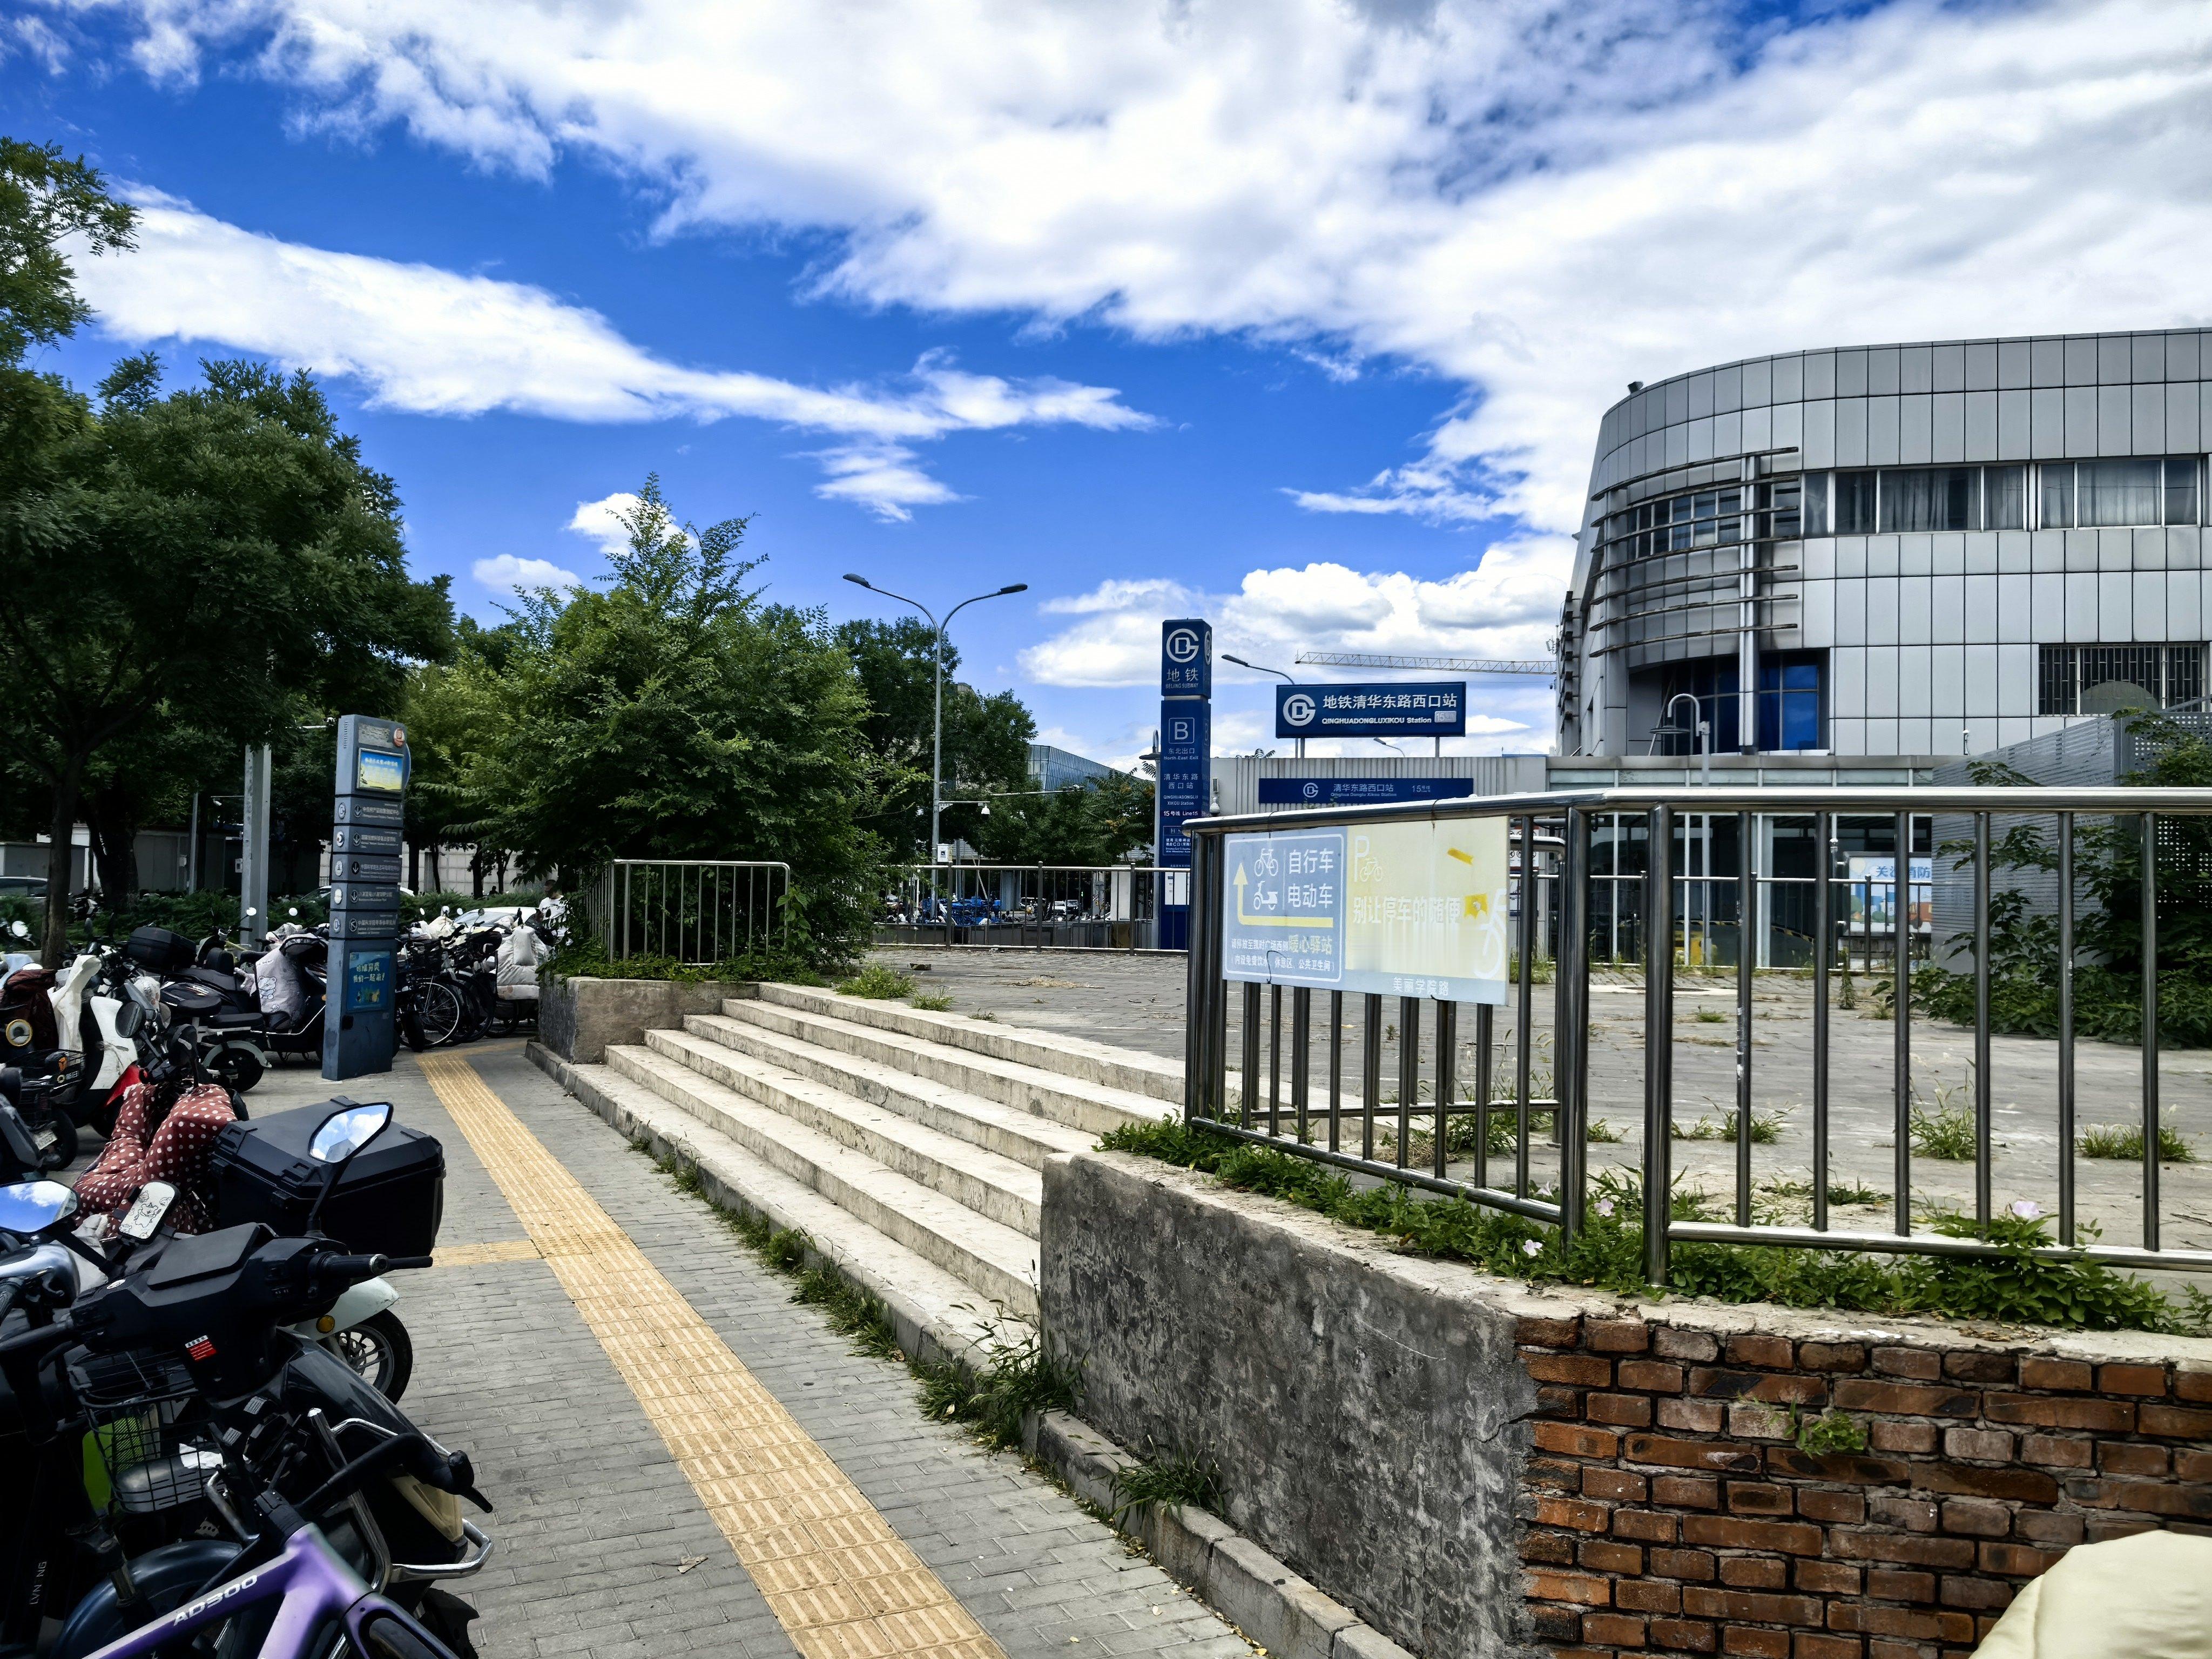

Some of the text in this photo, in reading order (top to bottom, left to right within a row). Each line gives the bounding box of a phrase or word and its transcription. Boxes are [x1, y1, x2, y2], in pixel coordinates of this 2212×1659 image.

[1166, 667, 1199, 682] 地铁
[1323, 693, 1458, 710] 地铁清华东路西口站
[1175, 721, 1188, 740] B
[1333, 784, 1394, 792] 清华东路西口站
[1289, 848, 1334, 874] 自行车
[1354, 835, 1370, 882] P
[1287, 884, 1333, 908] 电动车
[1392, 977, 1449, 996] 美丽学院路
[29, 1561, 47, 1604] LVNNG
